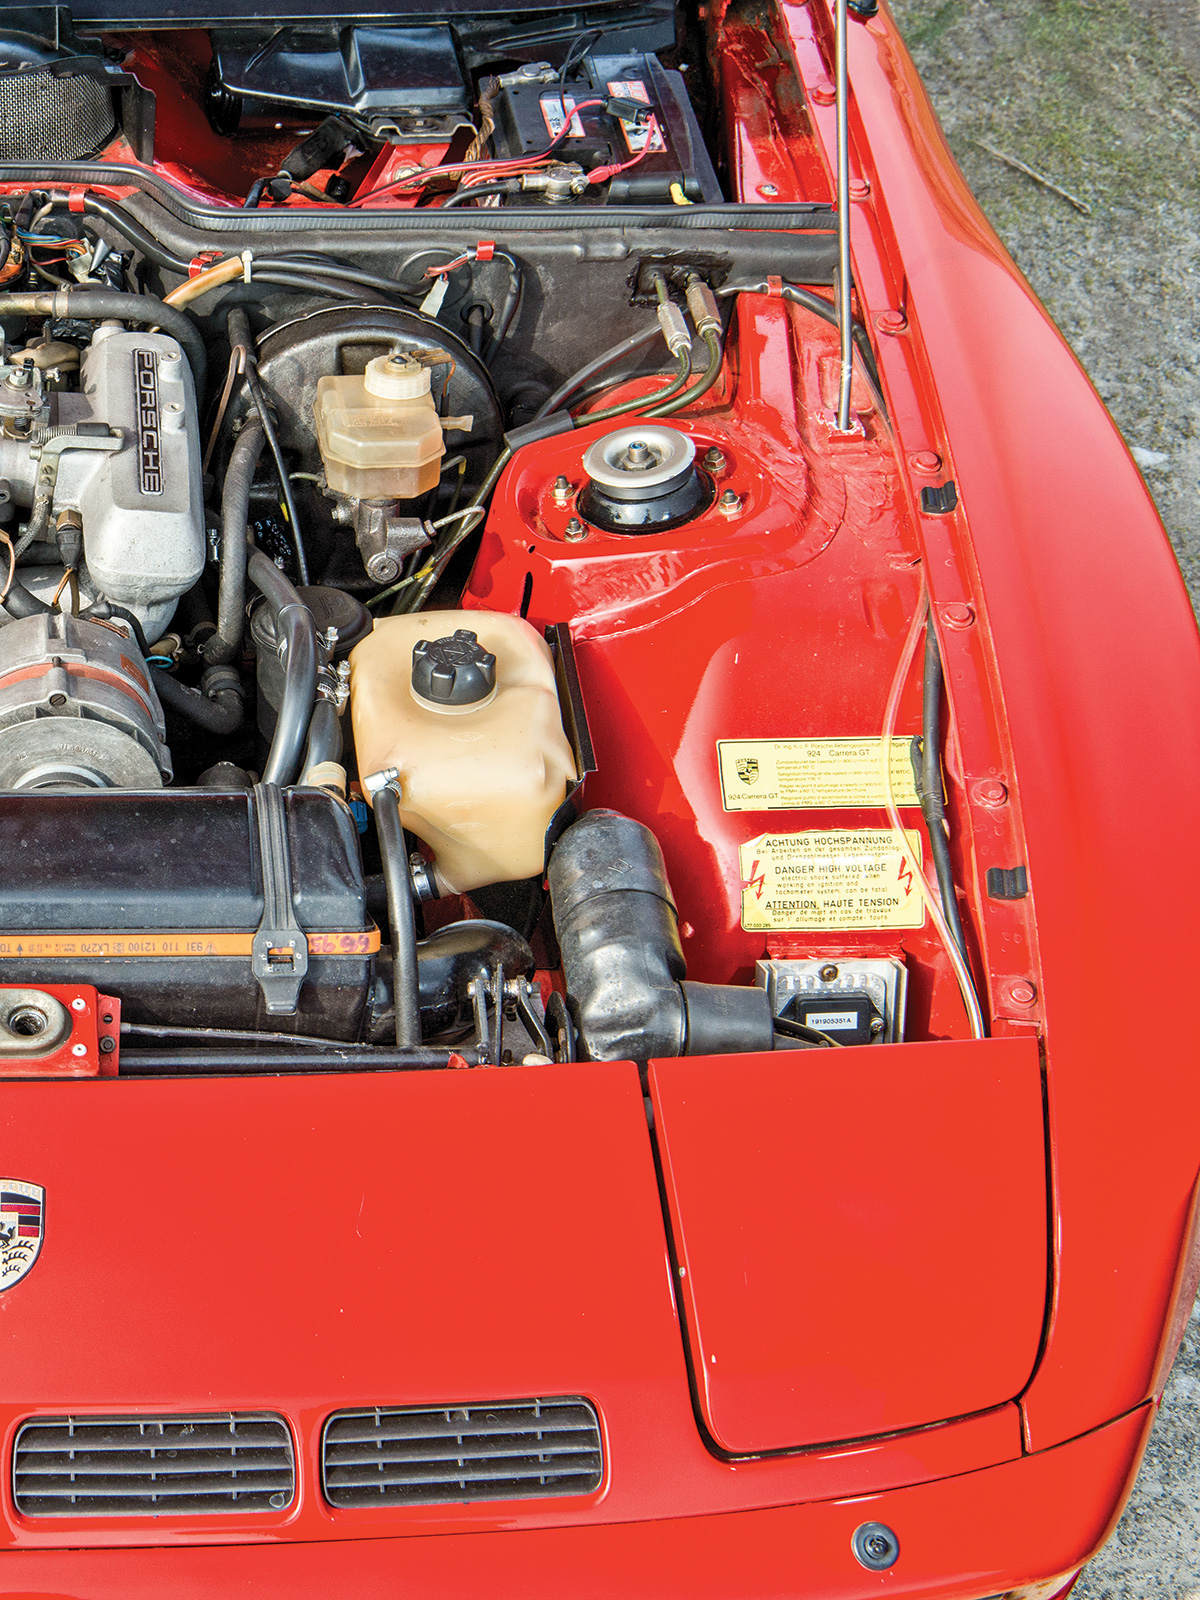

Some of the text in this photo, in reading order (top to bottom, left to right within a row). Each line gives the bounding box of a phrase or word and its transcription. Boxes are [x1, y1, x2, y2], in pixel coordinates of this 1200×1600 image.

[137, 350, 161, 492] PORSCHE
[828, 749, 857, 757] Carrera
[858, 748, 870, 756] GT
[768, 792, 779, 800] GT
[765, 836, 893, 847] ACHTUNG HOCHSPANNUNG
[774, 862, 887, 875] DANGER HIGH VOLTAGE
[823, 899, 854, 908] HAUTE
[858, 897, 899, 907] TENSION
[80, 942, 109, 953] LX270
[128, 942, 156, 952] 12100
[162, 942, 179, 952] 110
[186, 942, 203, 952] 931
[811, 1017, 852, 1025] 191905351A
